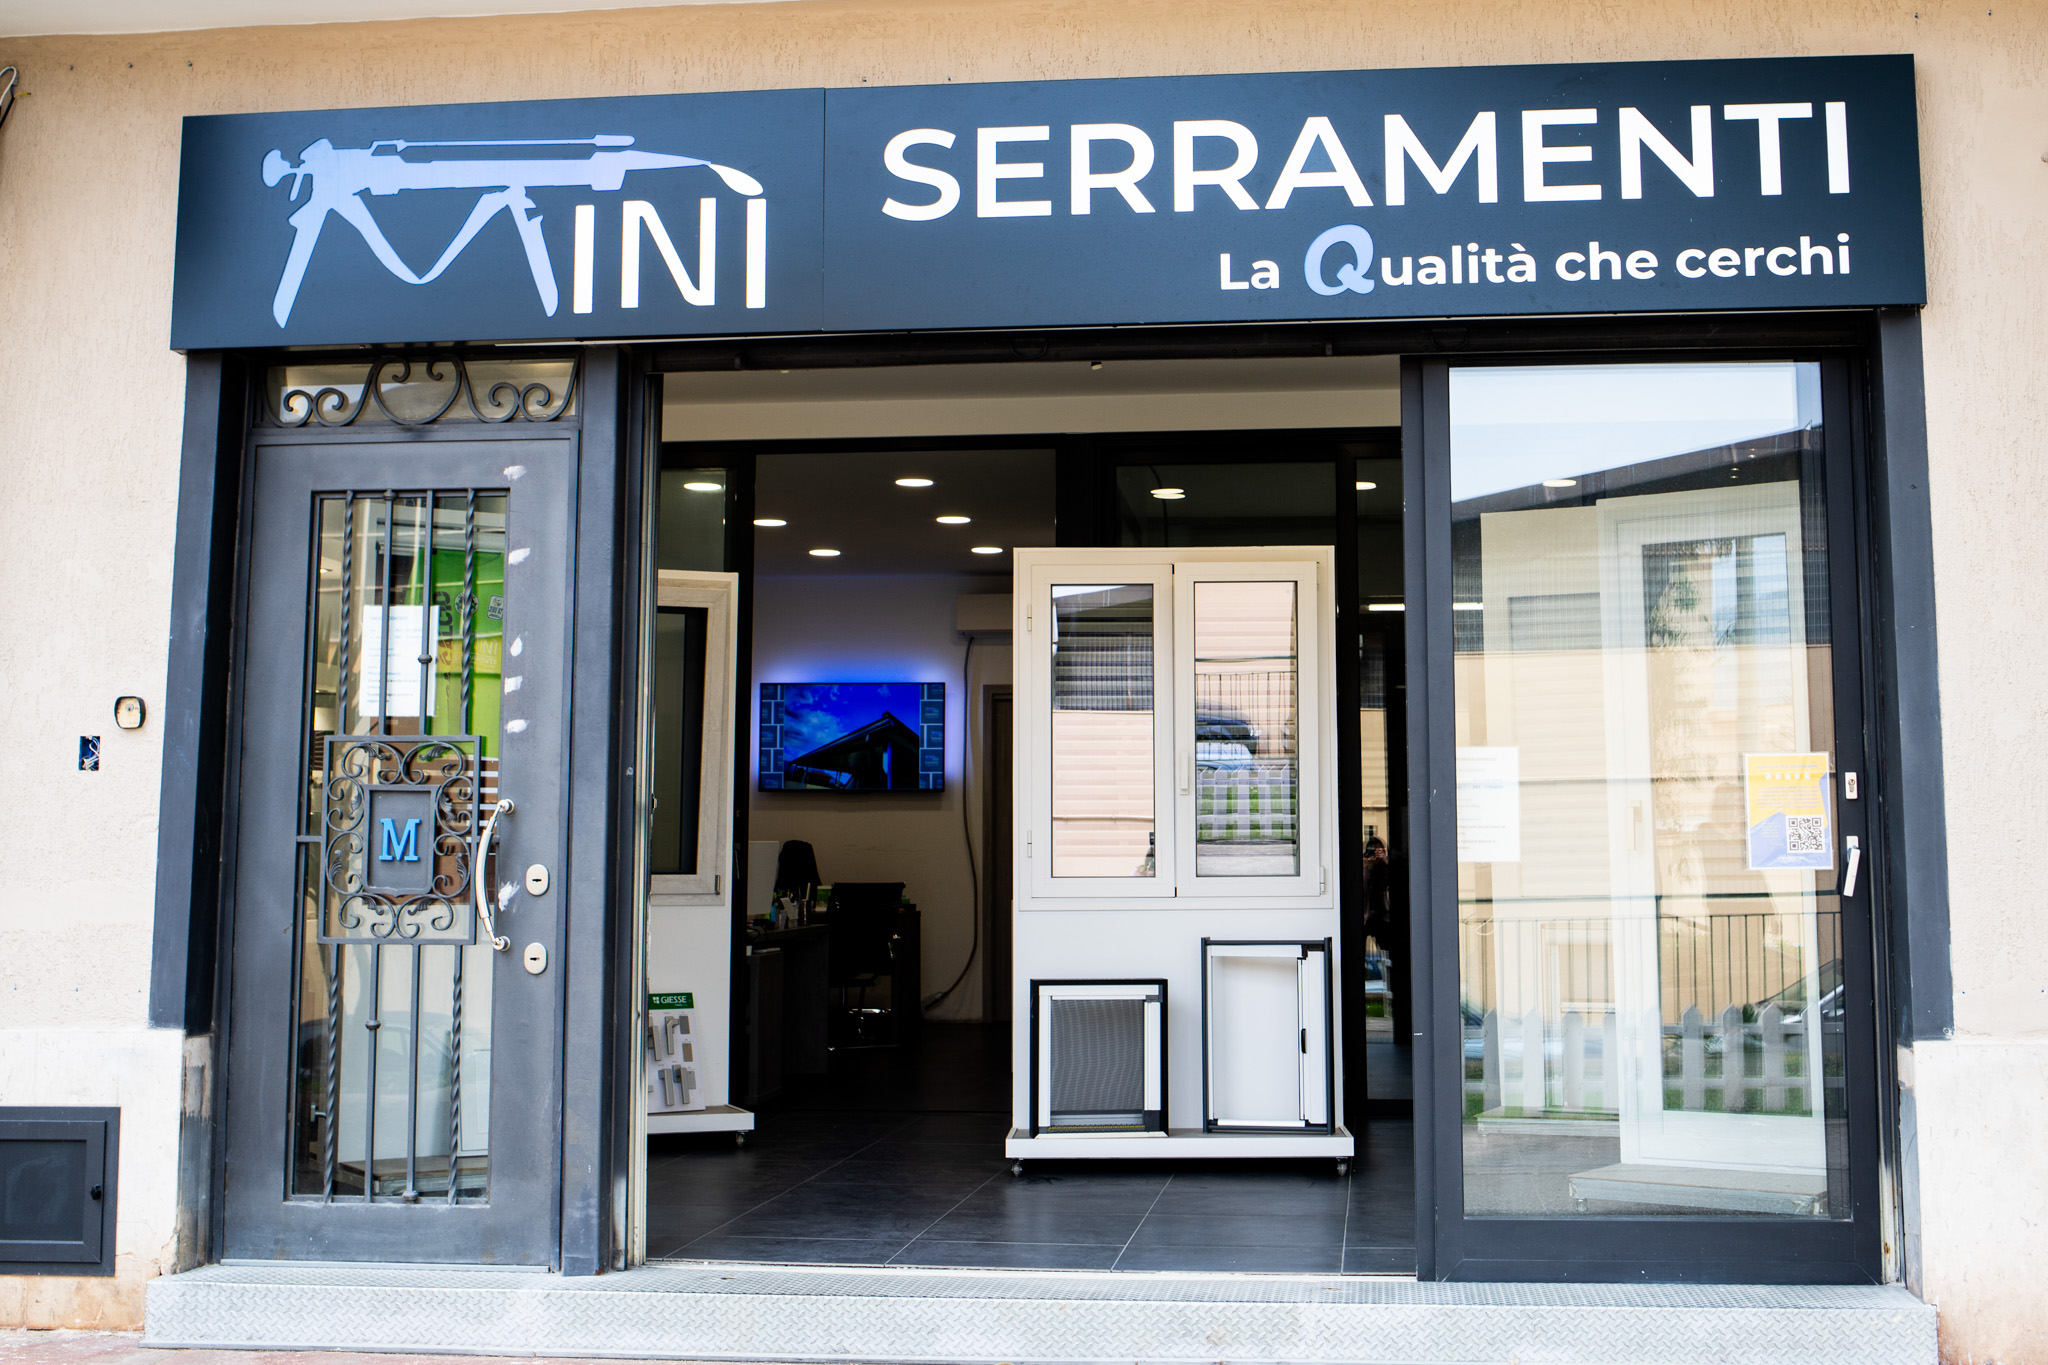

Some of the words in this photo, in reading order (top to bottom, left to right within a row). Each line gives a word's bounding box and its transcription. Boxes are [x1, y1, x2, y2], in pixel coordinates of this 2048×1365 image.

[881, 100, 1851, 222] SERRAMENTI
[1219, 252, 1281, 291] La
[1303, 223, 1537, 296] Qualità
[1554, 240, 1659, 282] che
[1675, 231, 1851, 279] cerchi
[377, 817, 422, 862] M
[660, 995, 687, 1005] GIESSE
